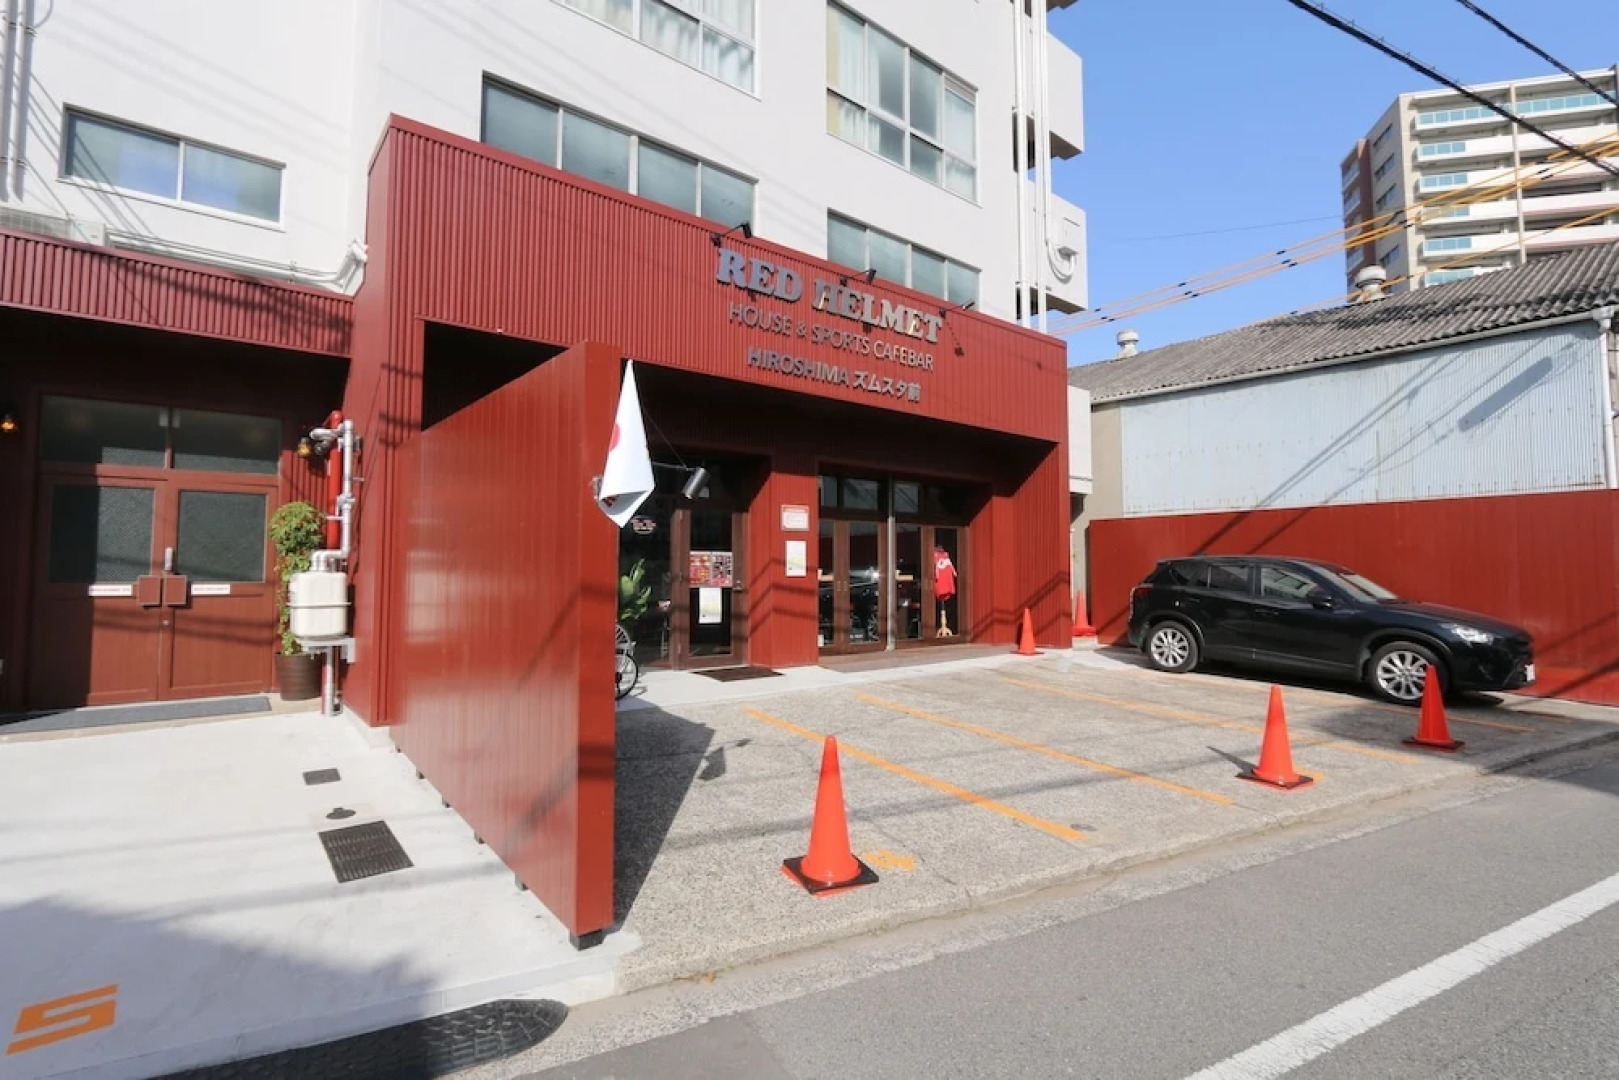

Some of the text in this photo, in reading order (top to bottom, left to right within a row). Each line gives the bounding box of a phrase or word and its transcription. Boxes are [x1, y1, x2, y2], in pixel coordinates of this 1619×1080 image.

[716, 248, 943, 343] RED HELMET
[729, 301, 933, 370] HOUSE & SPORTS CAFEBAR
[747, 347, 849, 386] HIROSHIMA
